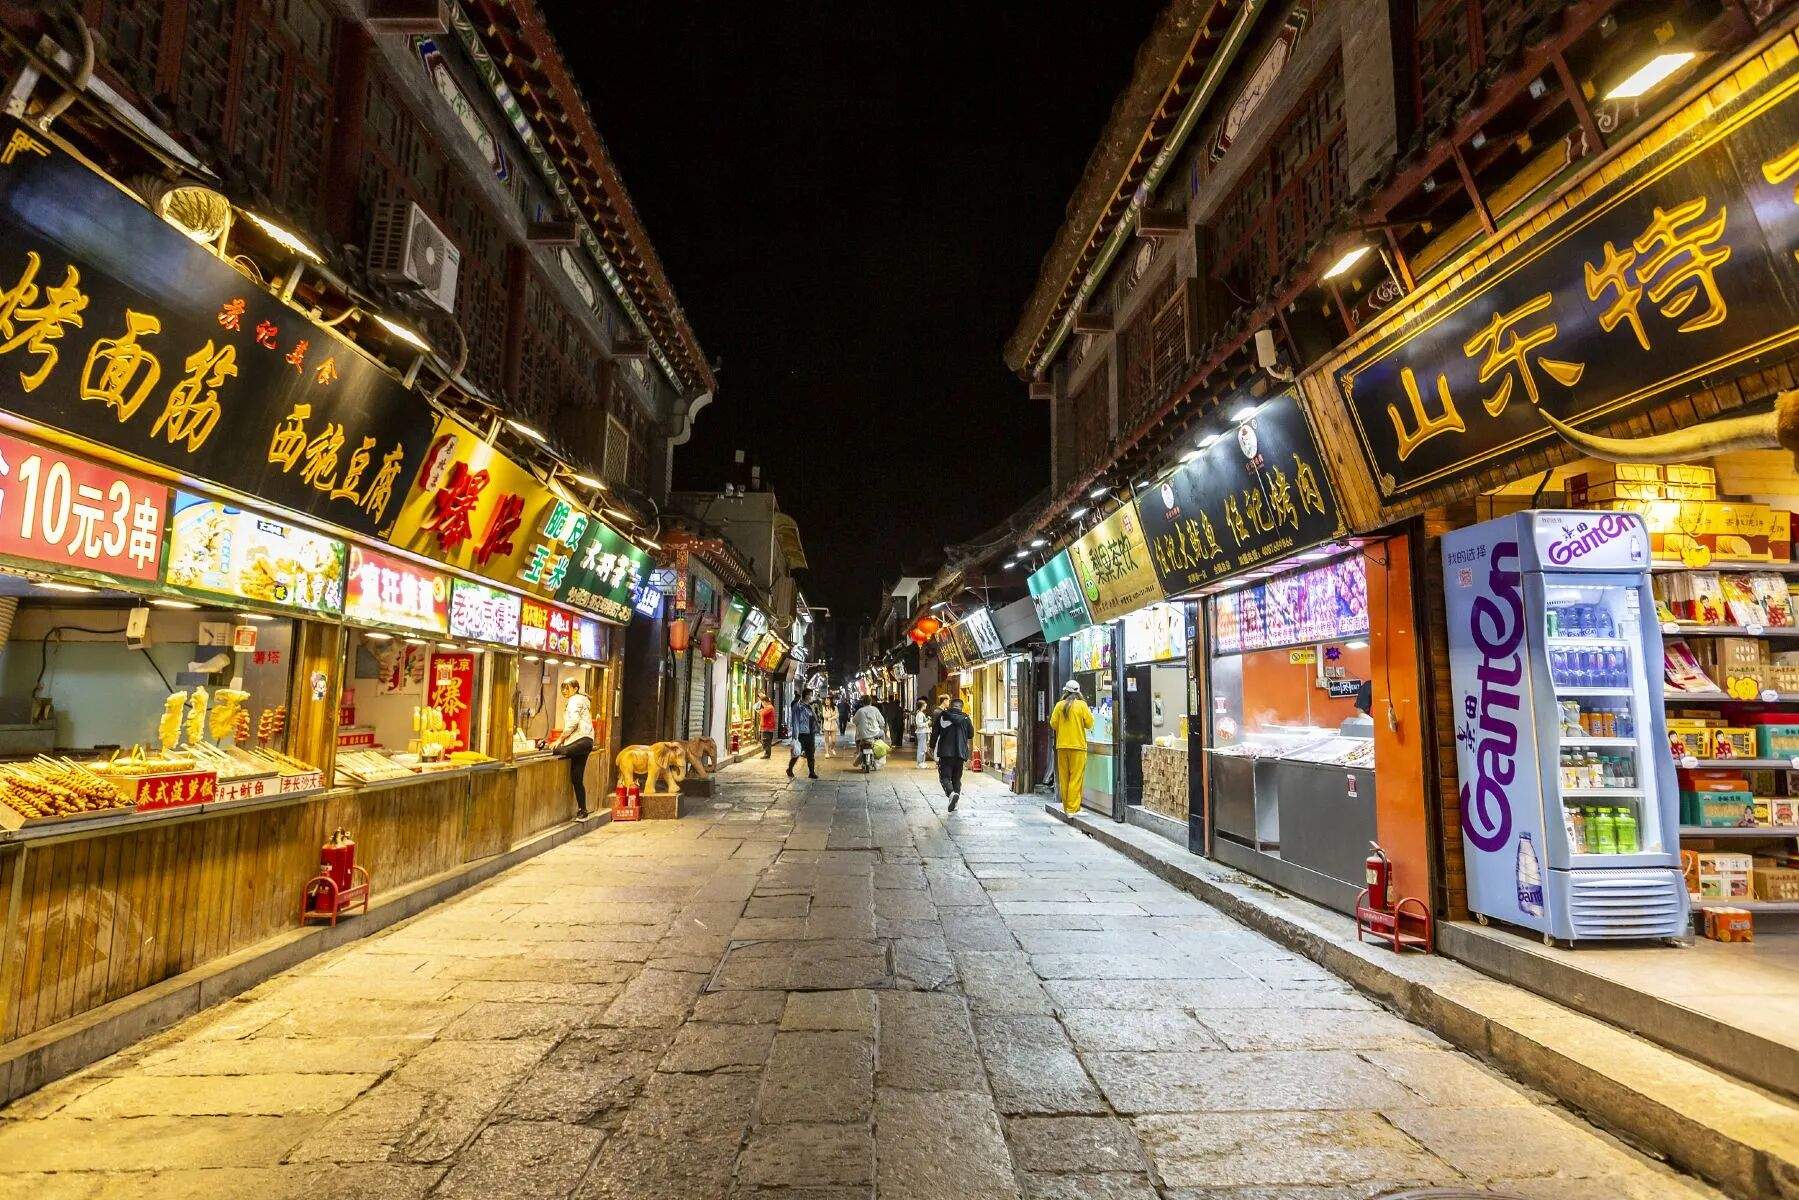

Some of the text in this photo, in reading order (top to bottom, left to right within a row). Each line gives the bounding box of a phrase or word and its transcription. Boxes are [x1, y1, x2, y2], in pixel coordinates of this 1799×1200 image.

[0, 251, 239, 453] 烤面筋
[1387, 147, 1799, 462] 山东特
[0, 453, 158, 570] 10元3串
[1448, 544, 1488, 566] 我的选择
[253, 651, 281, 665] 薯塔
